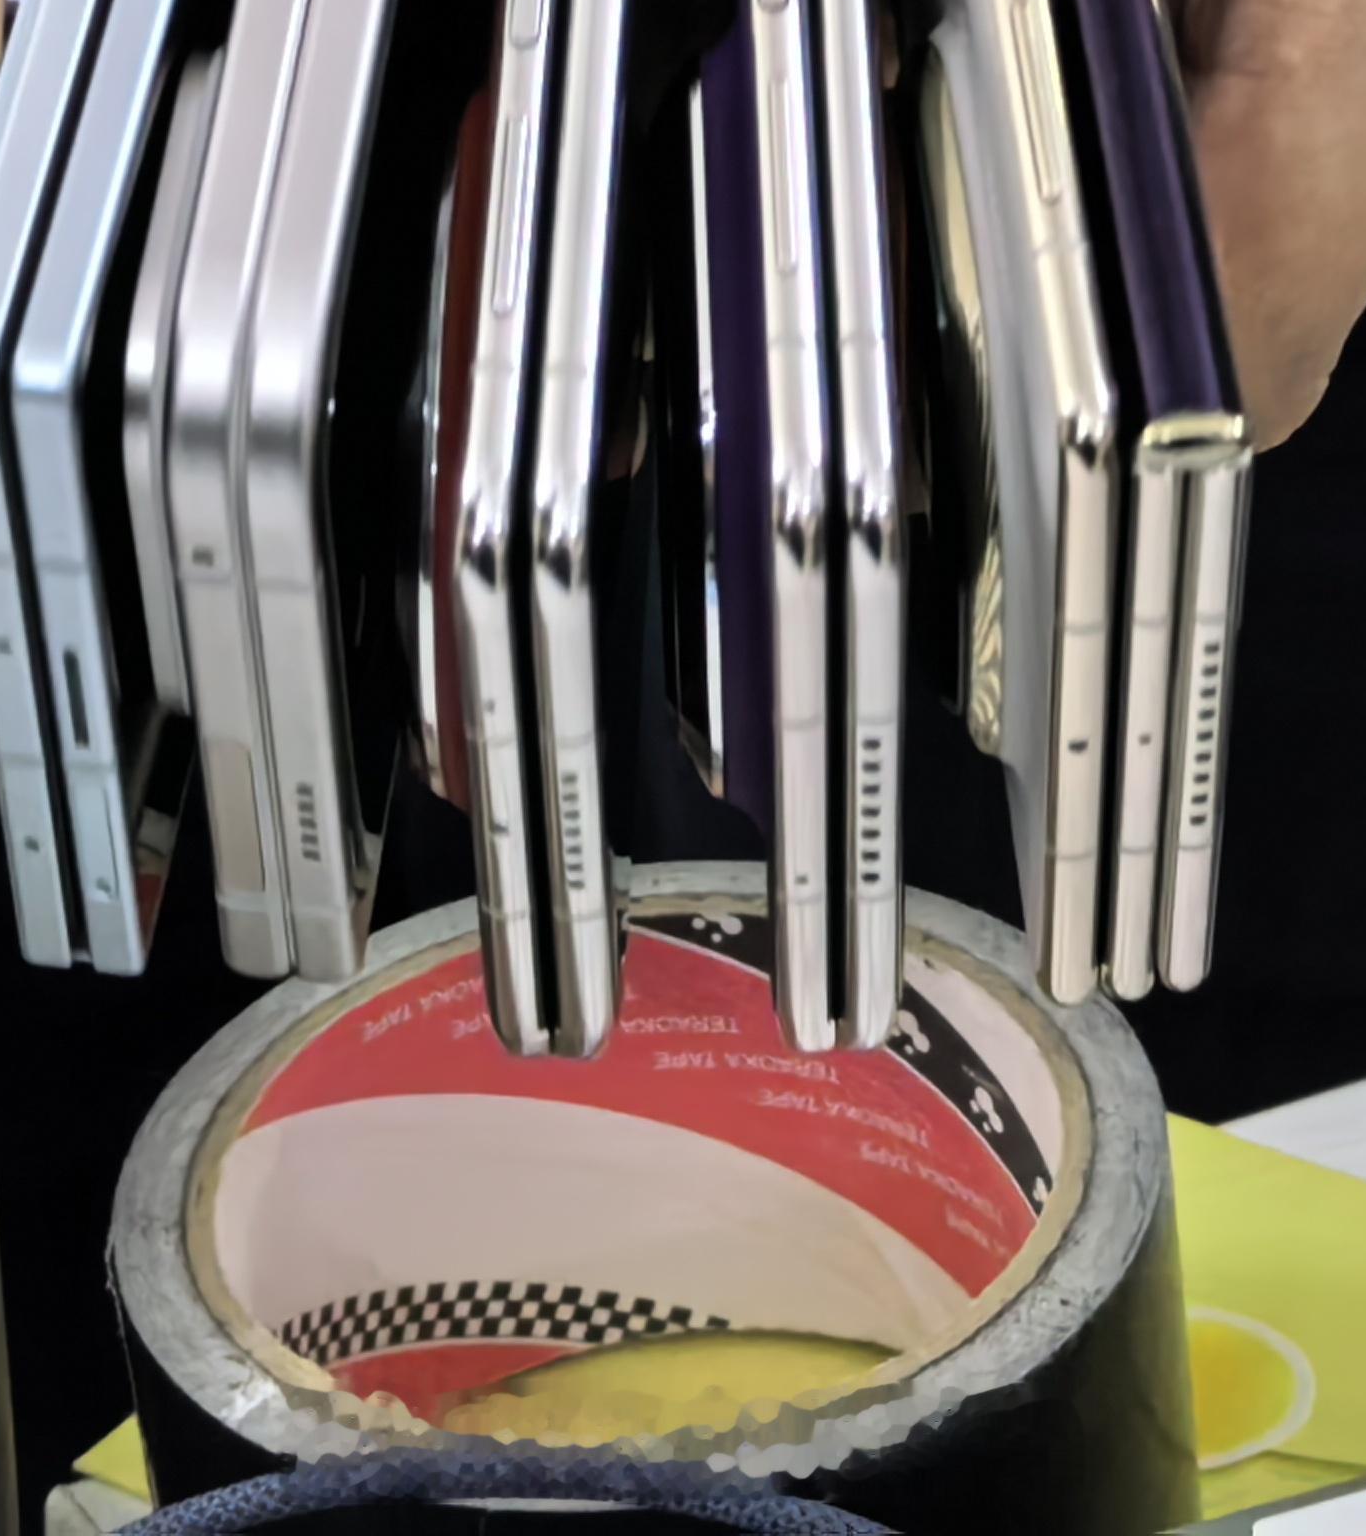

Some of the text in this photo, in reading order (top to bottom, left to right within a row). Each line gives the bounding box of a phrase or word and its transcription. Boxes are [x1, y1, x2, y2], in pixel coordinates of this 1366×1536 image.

[361, 975, 485, 1044] AOKA TAPE
[652, 1050, 841, 1086] TERAOKA TAPE
[756, 1087, 821, 1114] TAPE
